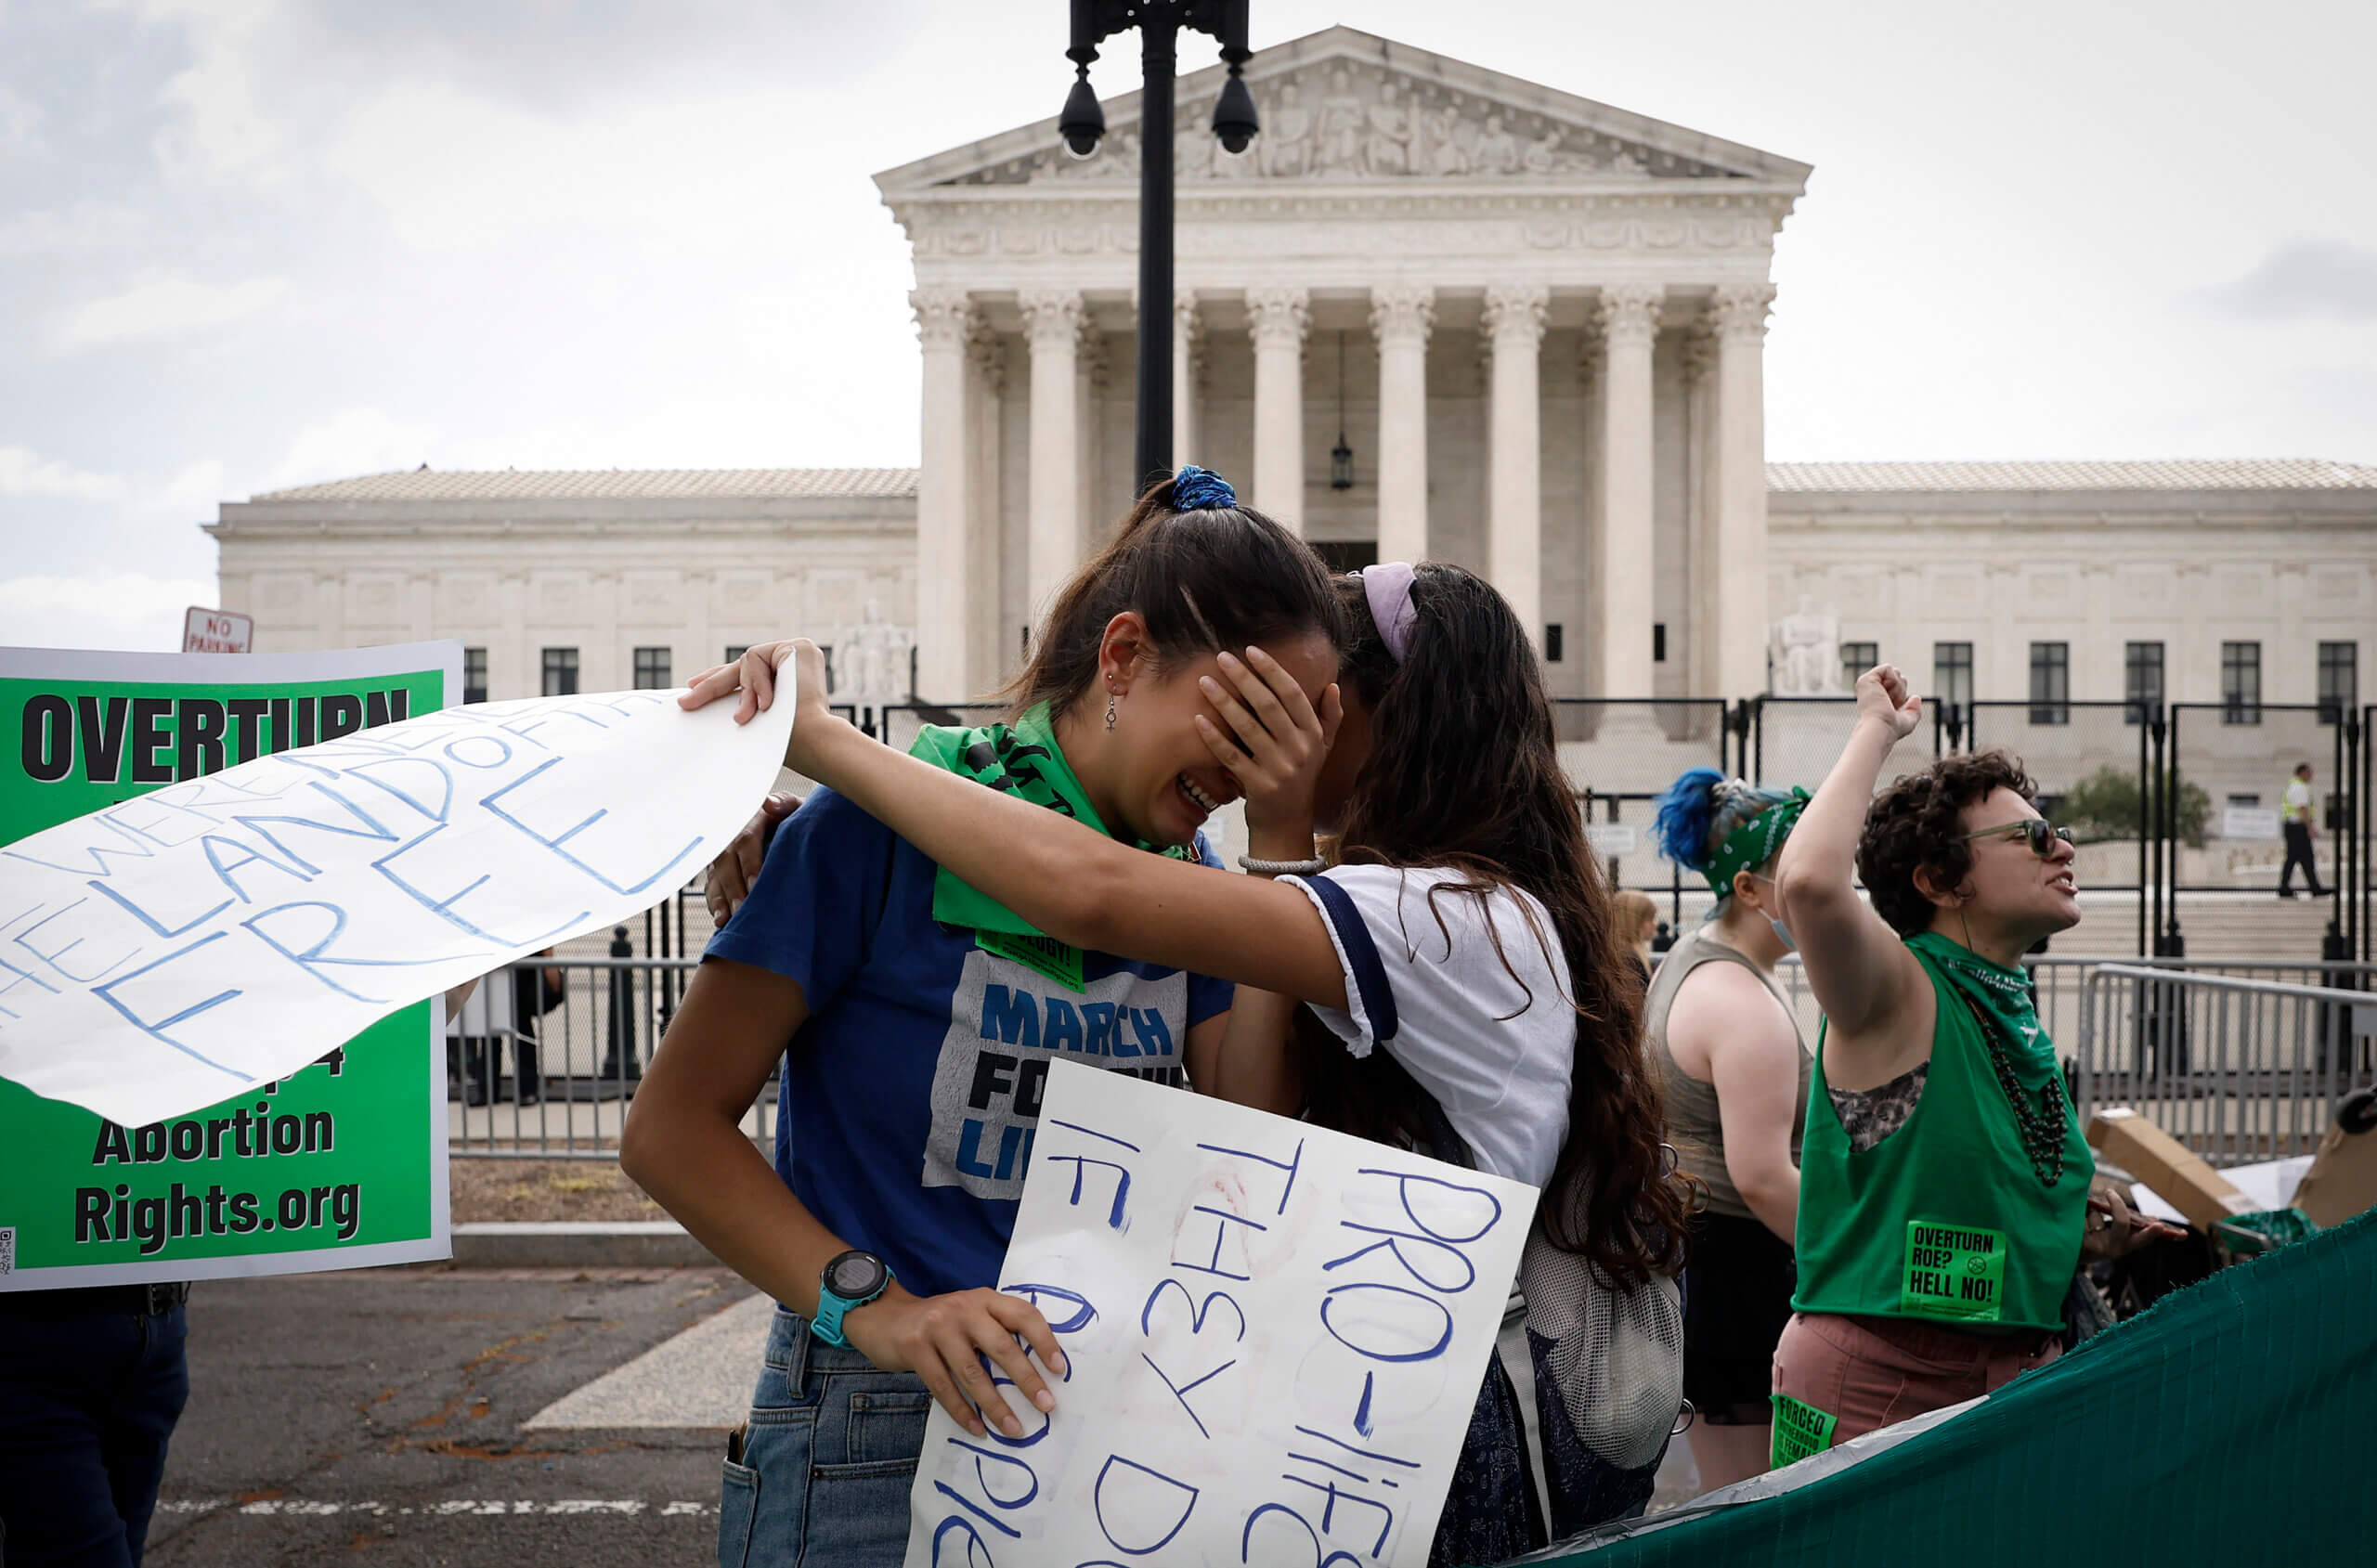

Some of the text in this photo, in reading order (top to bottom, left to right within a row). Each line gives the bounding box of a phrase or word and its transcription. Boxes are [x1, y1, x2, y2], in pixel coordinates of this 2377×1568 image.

[208, 616, 231, 637] NO
[86, 757, 455, 939] LAND
[89, 756, 706, 1083] FREE
[981, 983, 1174, 1057] MARCH
[92, 1100, 335, 1166] Abortion
[1048, 1120, 1141, 1229] IF
[74, 1182, 362, 1255] Rights.org
[1915, 1226, 1994, 1254] OVERTURN
[1910, 1270, 1994, 1302] HELL NO!
[1912, 1247, 1954, 1269] ROE?
[1779, 1396, 1825, 1436] FORCED
